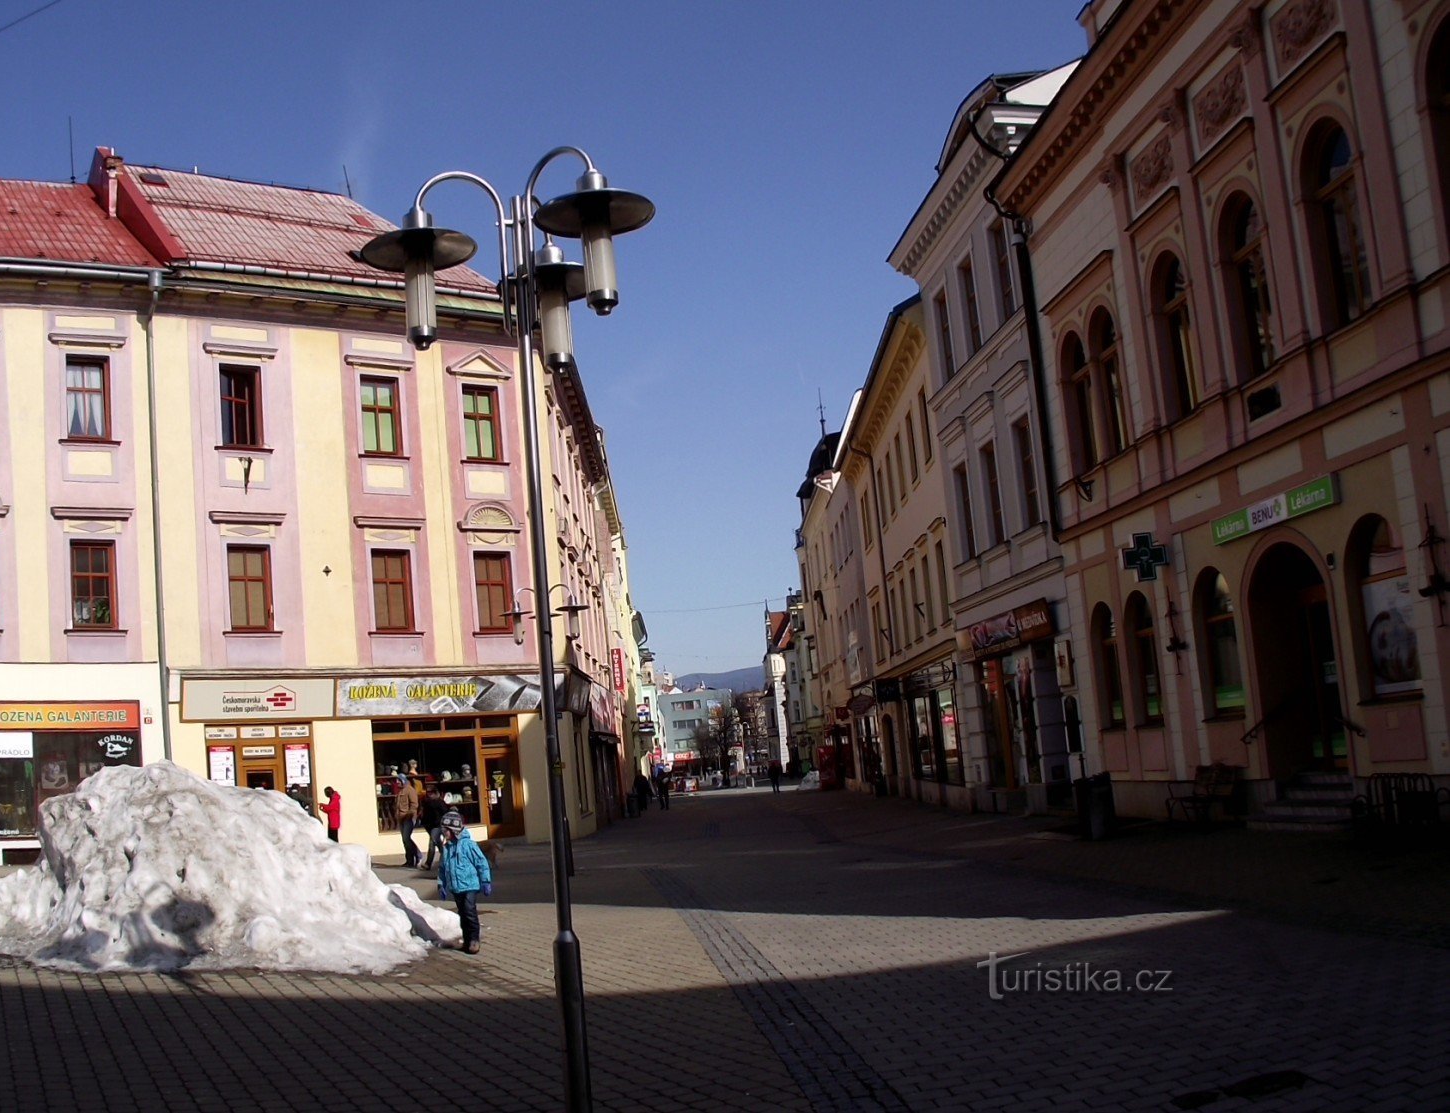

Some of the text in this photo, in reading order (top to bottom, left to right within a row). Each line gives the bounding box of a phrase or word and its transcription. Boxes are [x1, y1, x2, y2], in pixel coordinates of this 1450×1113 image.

[1216, 488, 1326, 538] Lékárna BENU Lékárna
[612, 649, 621, 687] INTERNET
[406, 684, 477, 699] GALANTERIE
[47, 709, 127, 723] GALANTERIE
[98, 734, 134, 747] KORDAN
